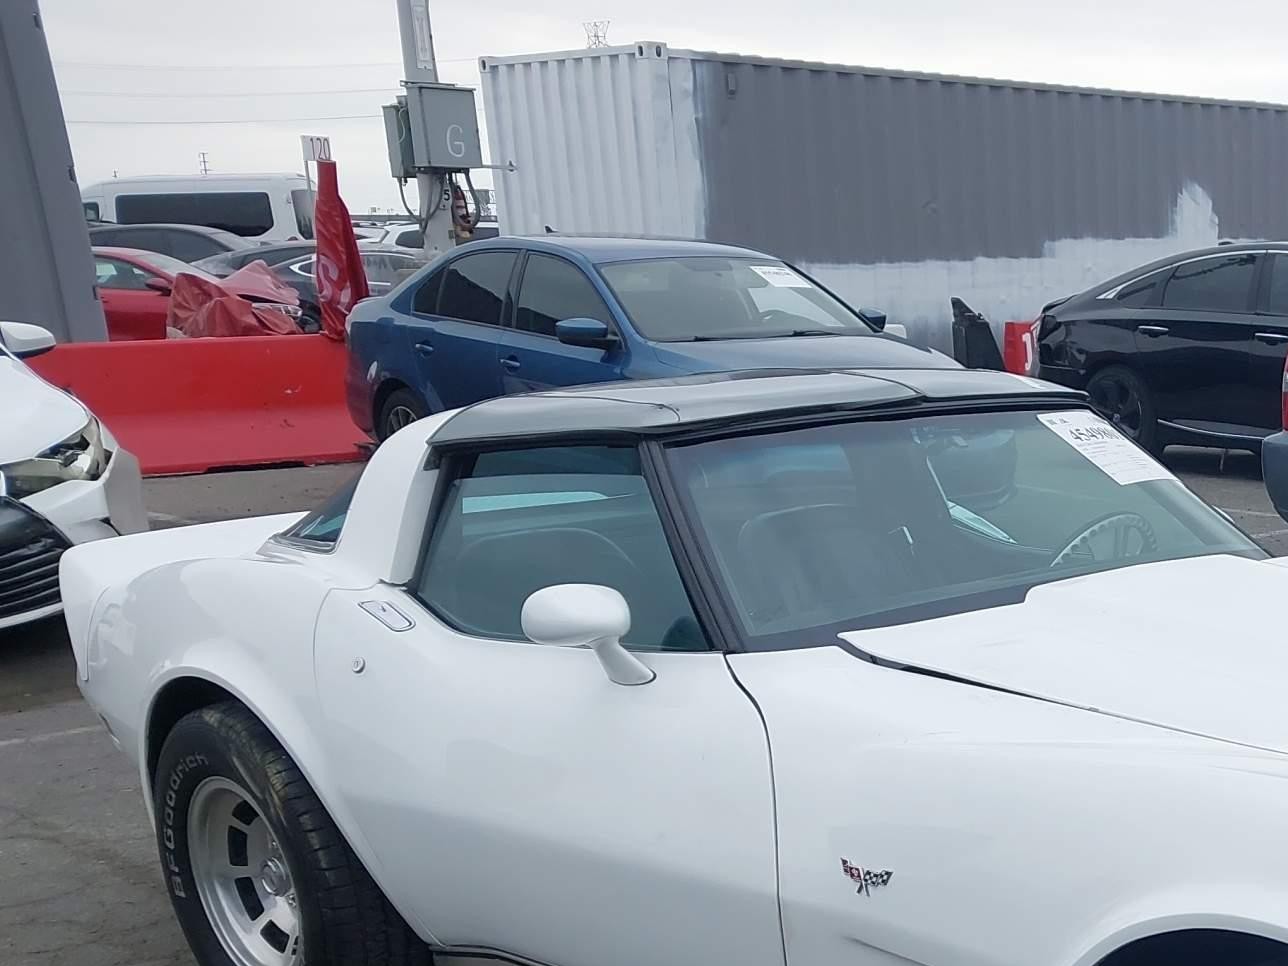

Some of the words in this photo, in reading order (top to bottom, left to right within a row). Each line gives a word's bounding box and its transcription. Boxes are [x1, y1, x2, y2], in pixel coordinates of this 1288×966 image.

[310, 137, 331, 161] 120
[446, 124, 465, 158] G
[163, 752, 209, 898] BFGoodrich
